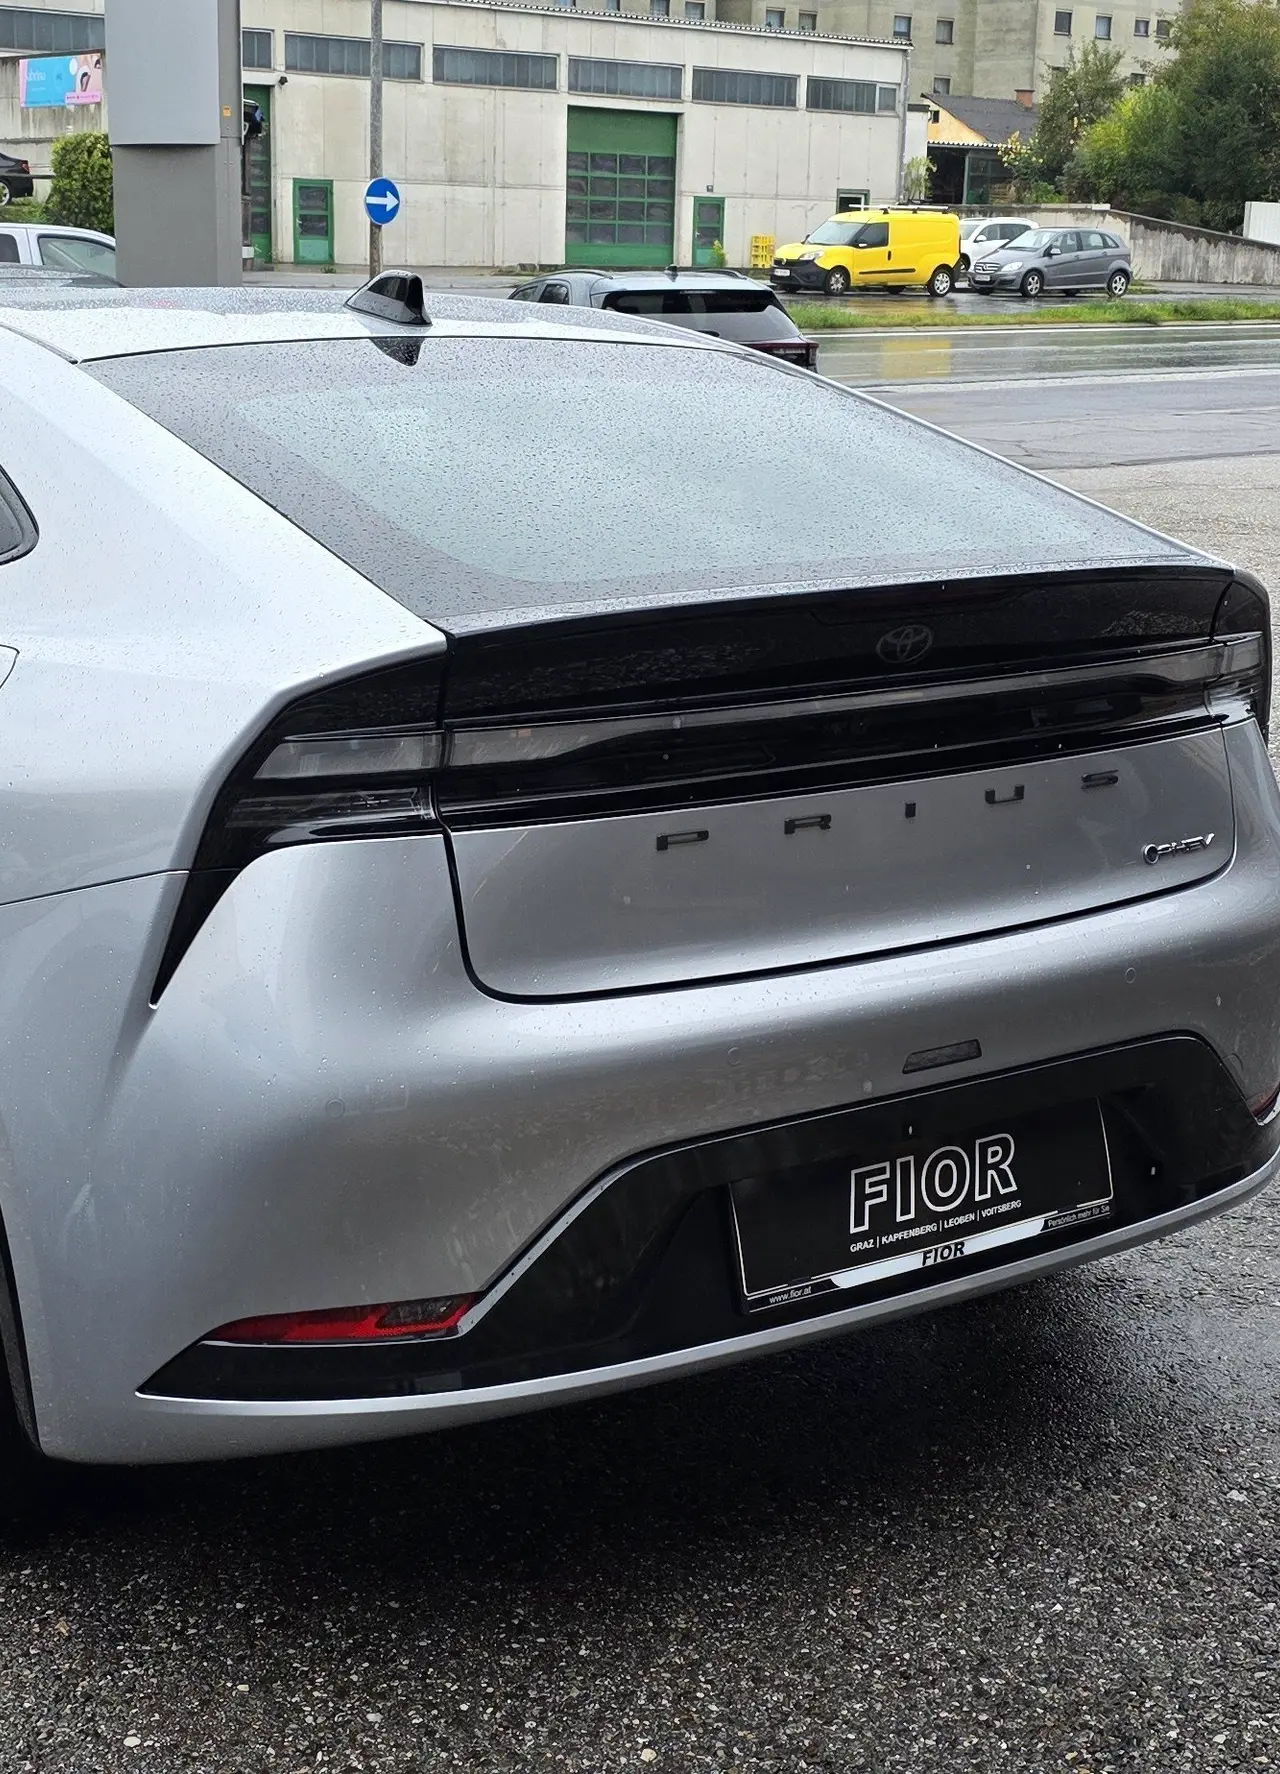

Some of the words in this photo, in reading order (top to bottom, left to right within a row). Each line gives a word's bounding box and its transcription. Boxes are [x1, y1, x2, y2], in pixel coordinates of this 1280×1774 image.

[656, 769, 1120, 851] PRIUS
[849, 1133, 1018, 1235] FIOR
[850, 1238, 875, 1253] GRAZ
[881, 1223, 938, 1245] KAPFENBERG
[944, 1212, 975, 1229] LEOBEN
[981, 1200, 1022, 1218] VOITSBERG
[1047, 1212, 1077, 1228] Persönlich
[1077, 1209, 1092, 1220] mehr
[1092, 1207, 1100, 1217] für
[1100, 1205, 1110, 1214] Sie
[921, 1241, 965, 1267] FIOR
[769, 1286, 812, 1304] www.fior.at
